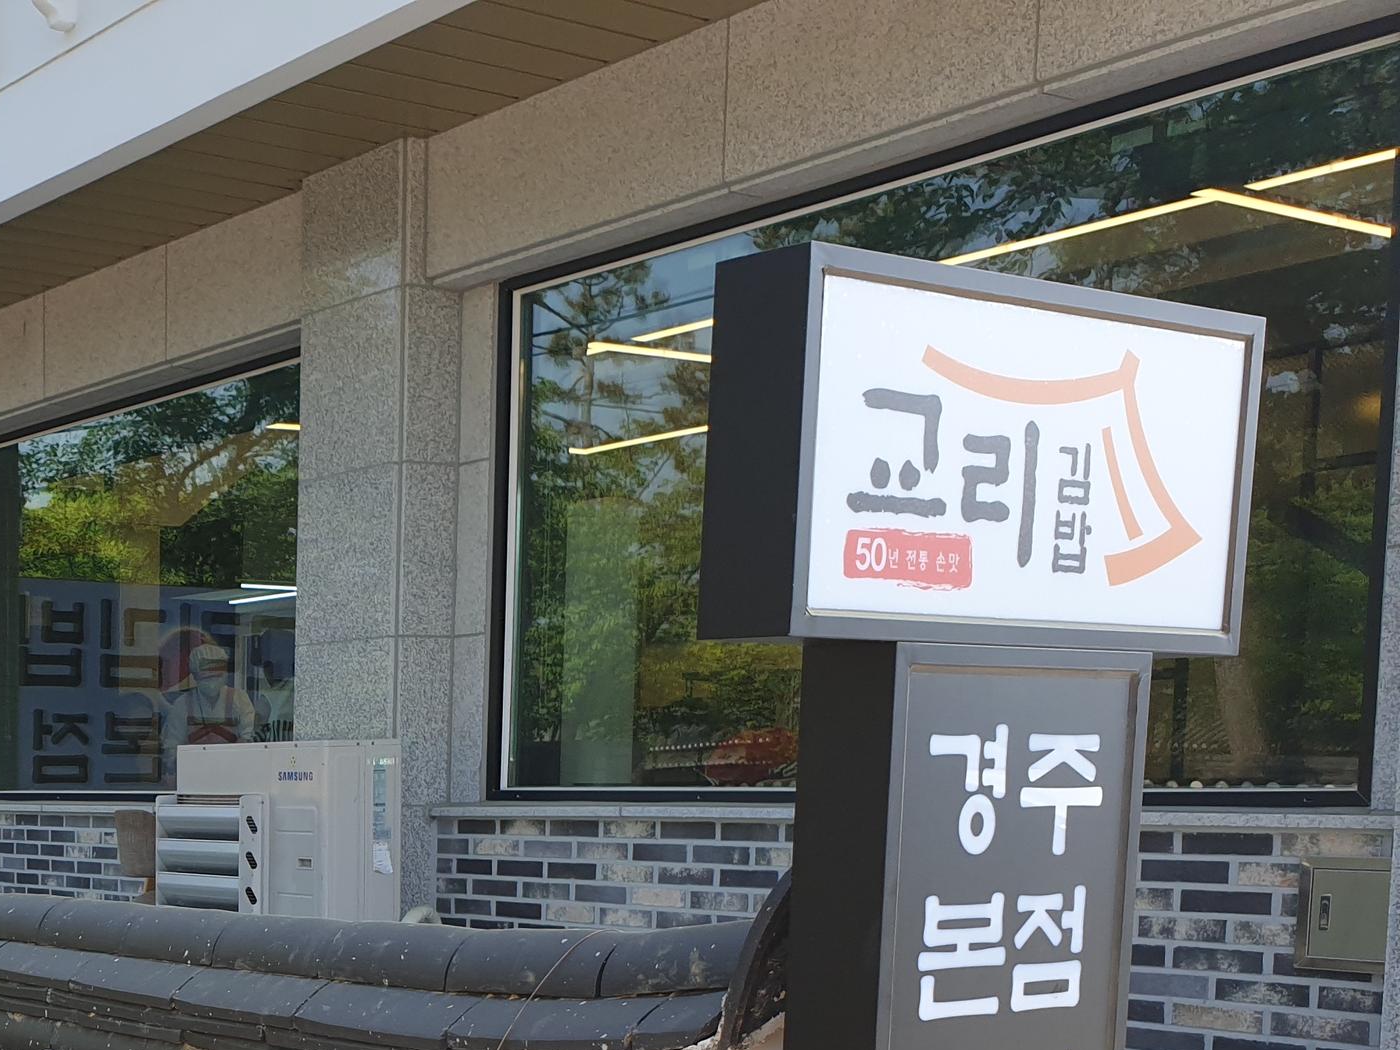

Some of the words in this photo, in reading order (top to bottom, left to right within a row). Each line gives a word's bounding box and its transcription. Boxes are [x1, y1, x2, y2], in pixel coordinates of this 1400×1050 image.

[846, 388, 1040, 568] 교리
[1051, 442, 1093, 575] 김밥
[855, 536, 899, 572] 50년
[905, 549, 929, 572] 전통
[935, 551, 961, 573] 손맛
[277, 771, 314, 782] SAMSUNG
[928, 723, 1103, 855] 경주
[917, 884, 1087, 1022] 본점
